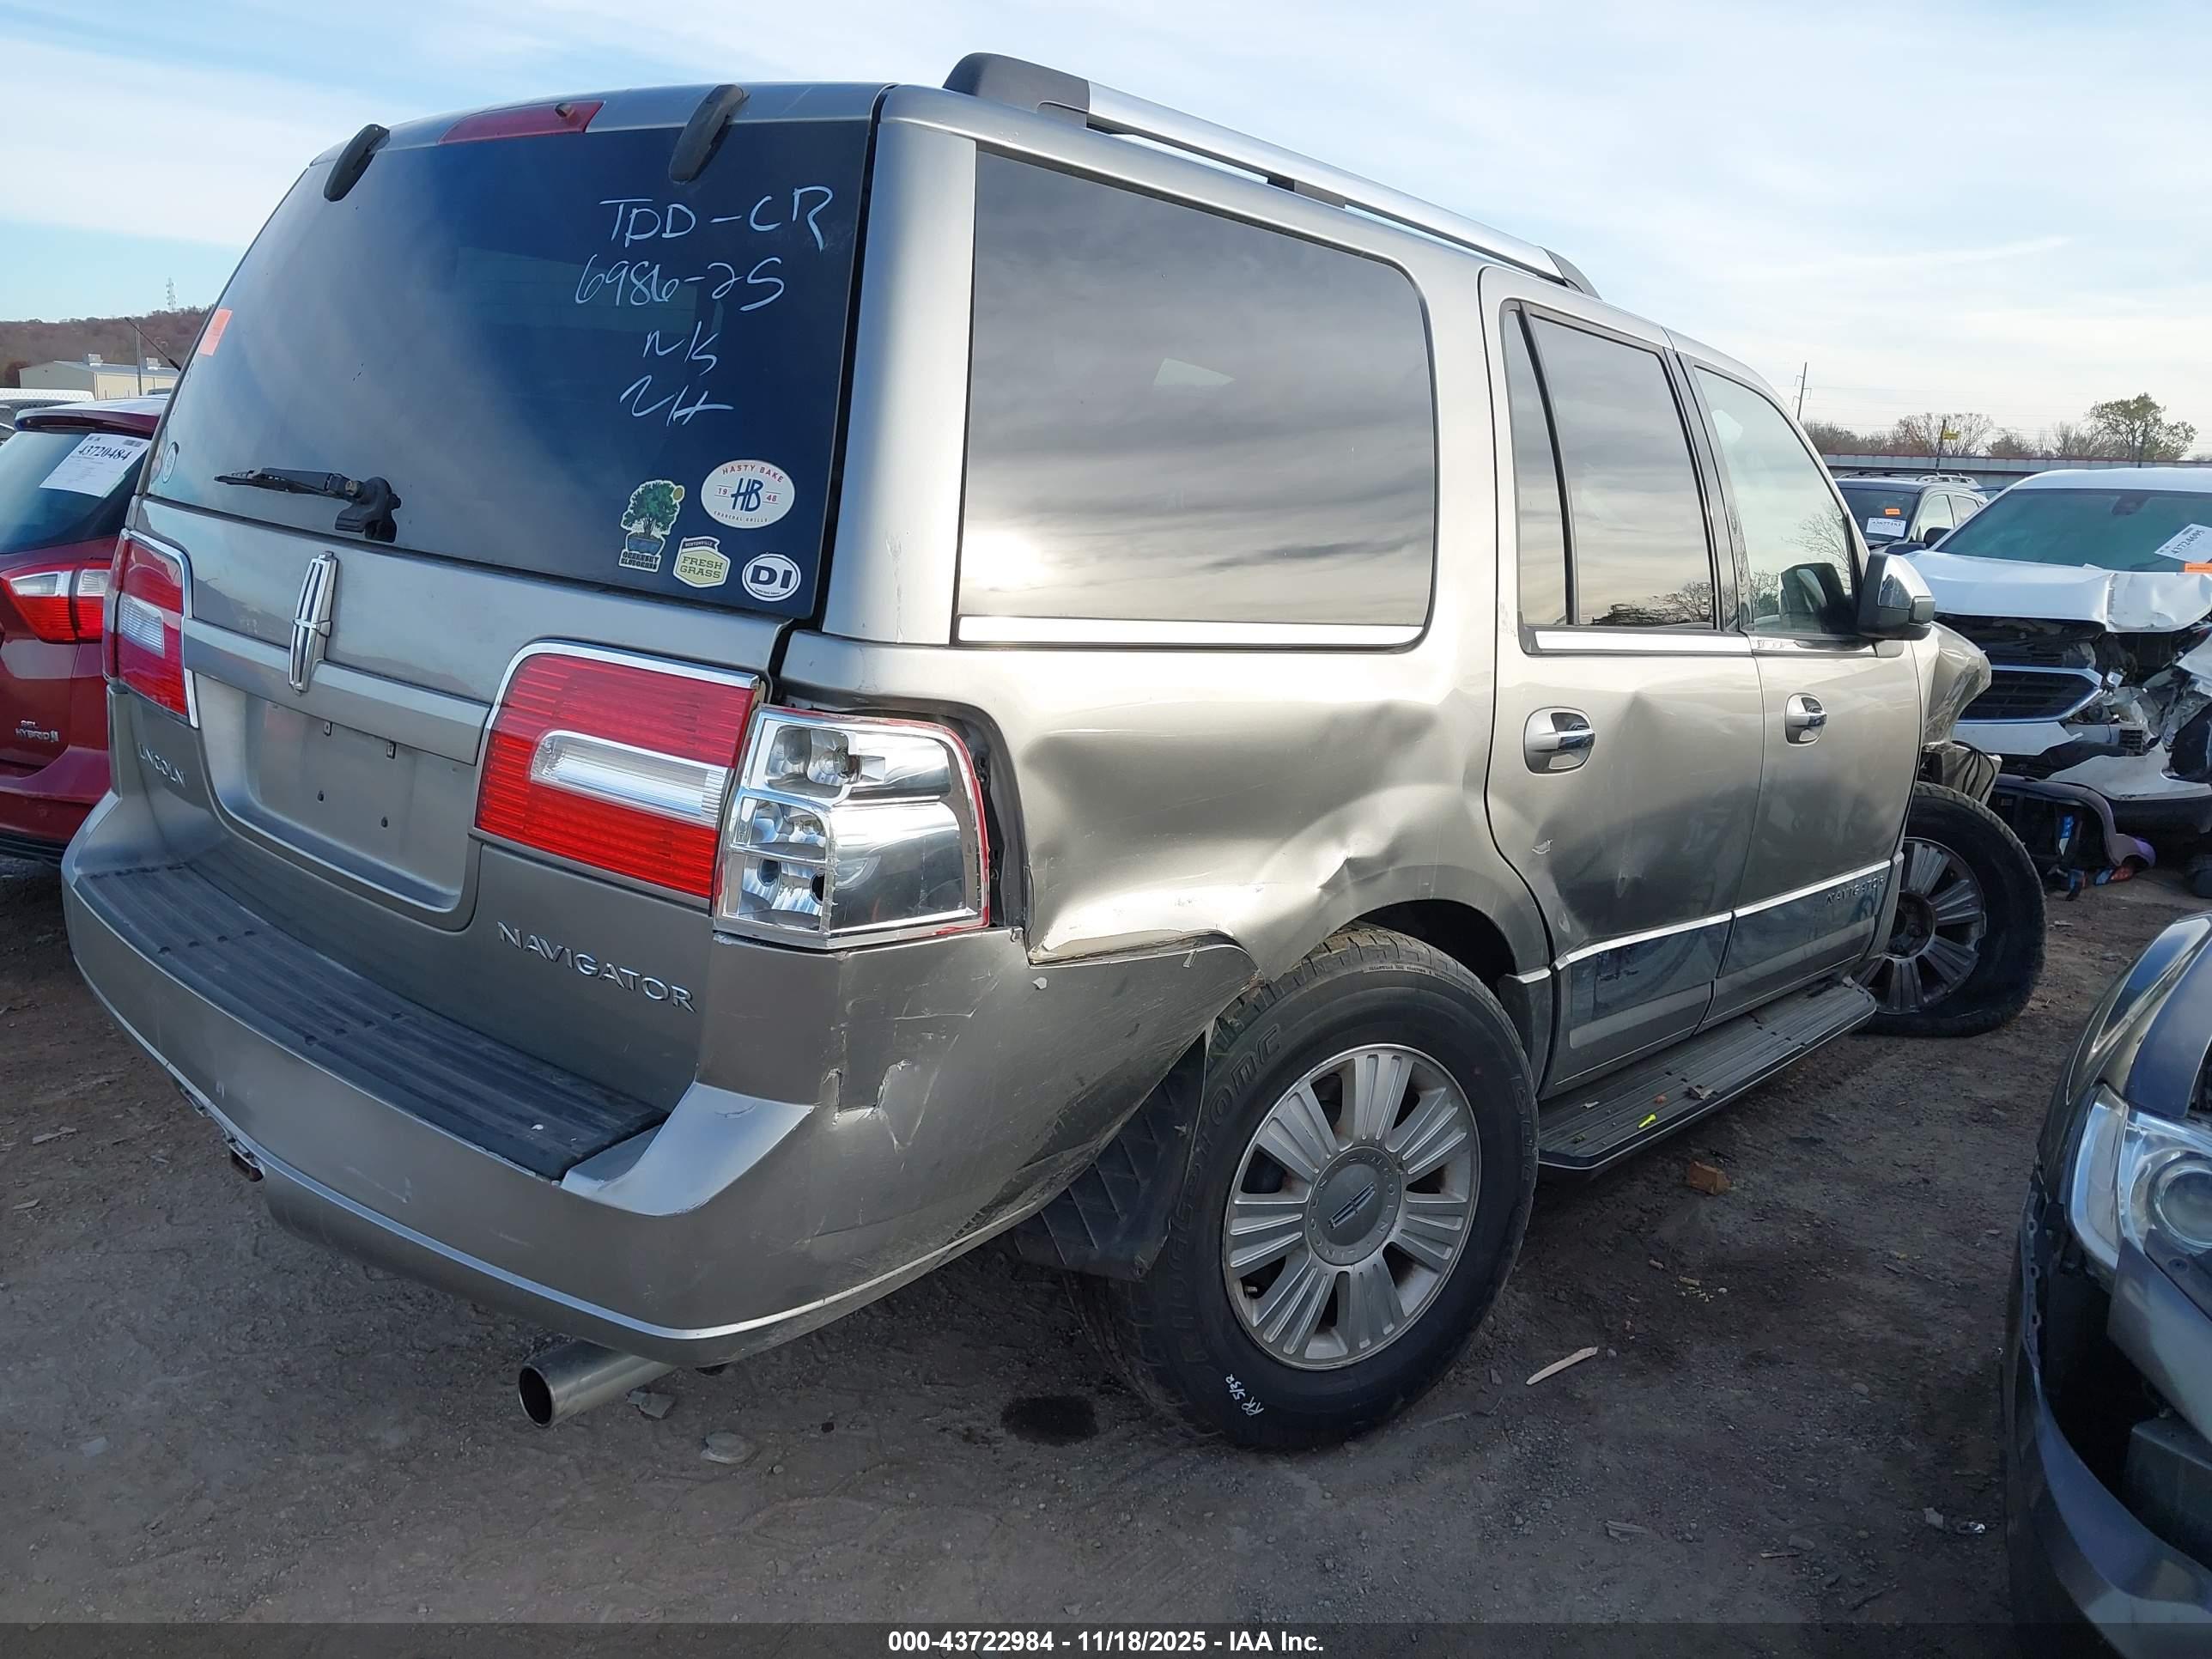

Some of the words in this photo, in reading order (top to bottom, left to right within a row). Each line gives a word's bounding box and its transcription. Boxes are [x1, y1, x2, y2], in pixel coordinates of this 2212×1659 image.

[722, 465, 756, 475] HASTY
[759, 466, 784, 483] BAKE
[718, 487, 728, 495] 19
[731, 477, 764, 513] HB
[679, 564, 721, 579] GRASS
[682, 556, 724, 570] FRESH
[750, 564, 793, 589] DI
[15, 727, 50, 740] HYBRID
[137, 741, 186, 788] LINCOLN
[496, 921, 696, 1013] NAVIGATOR
